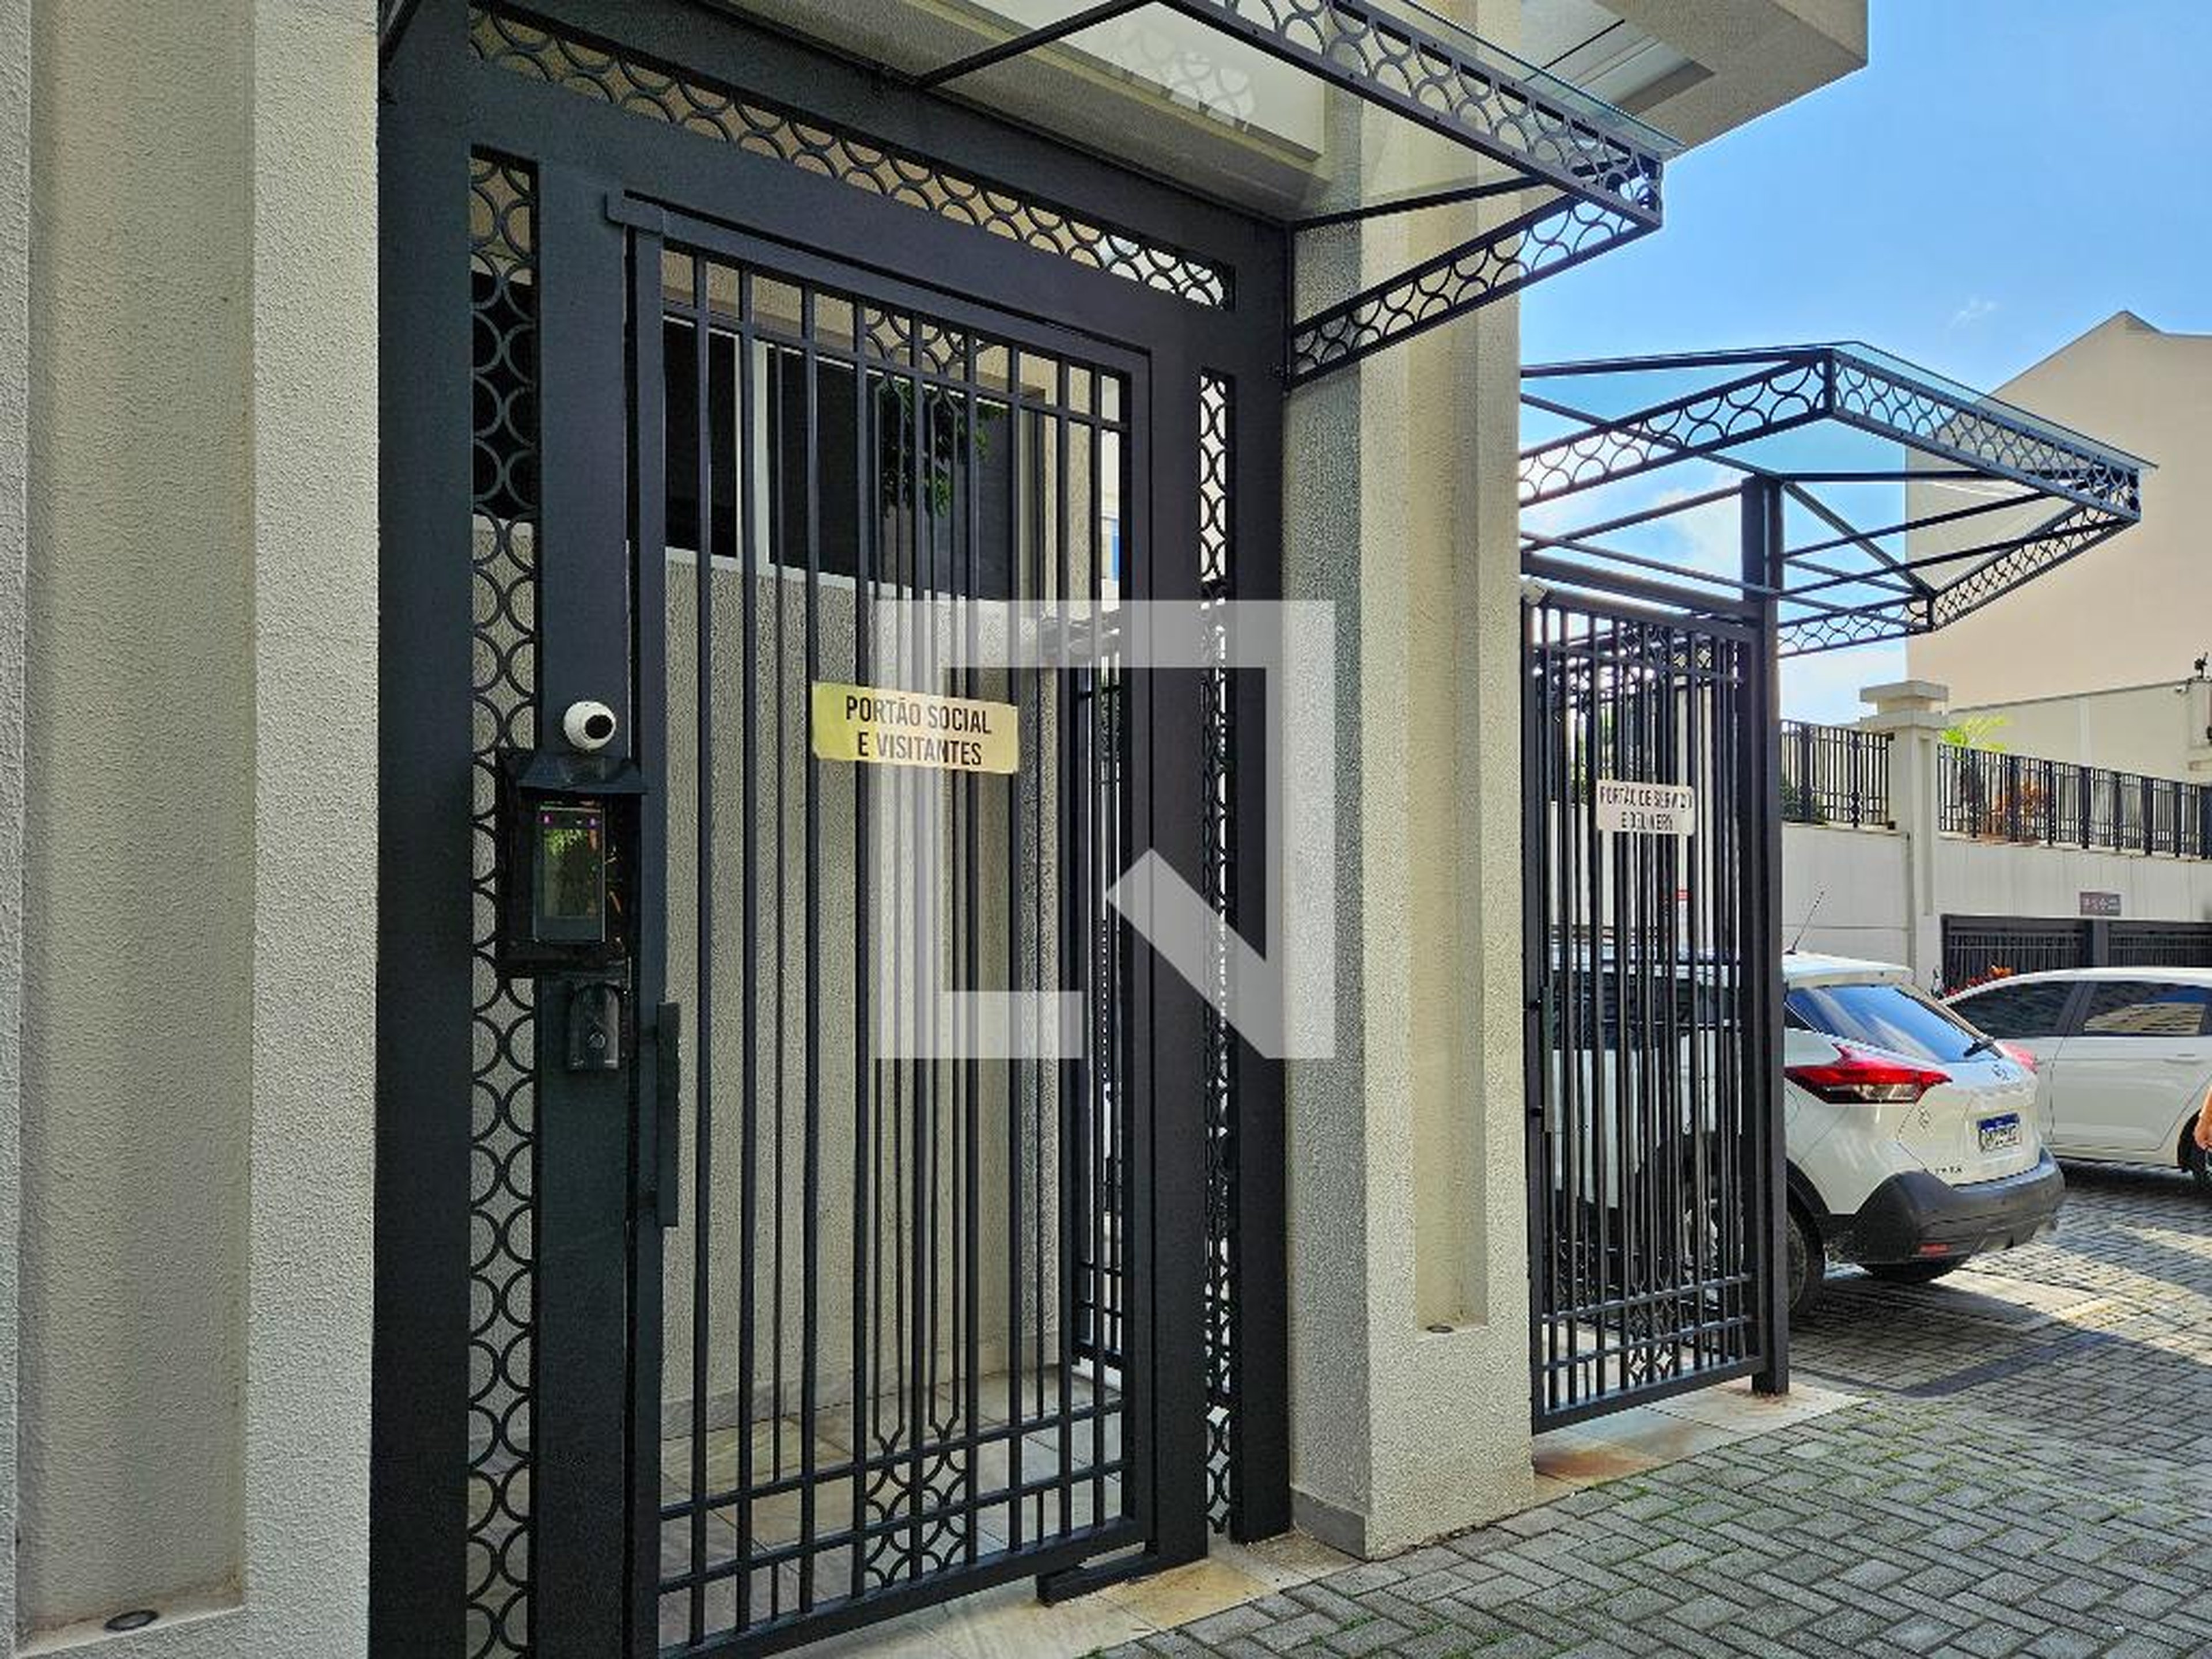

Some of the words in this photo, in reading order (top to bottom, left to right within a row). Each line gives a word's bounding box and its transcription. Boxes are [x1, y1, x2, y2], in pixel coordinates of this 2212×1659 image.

[846, 695, 921, 727] PORTÃO
[928, 705, 992, 734] SOCIAL
[858, 732, 869, 757] E
[876, 733, 982, 766] VISITANTES
